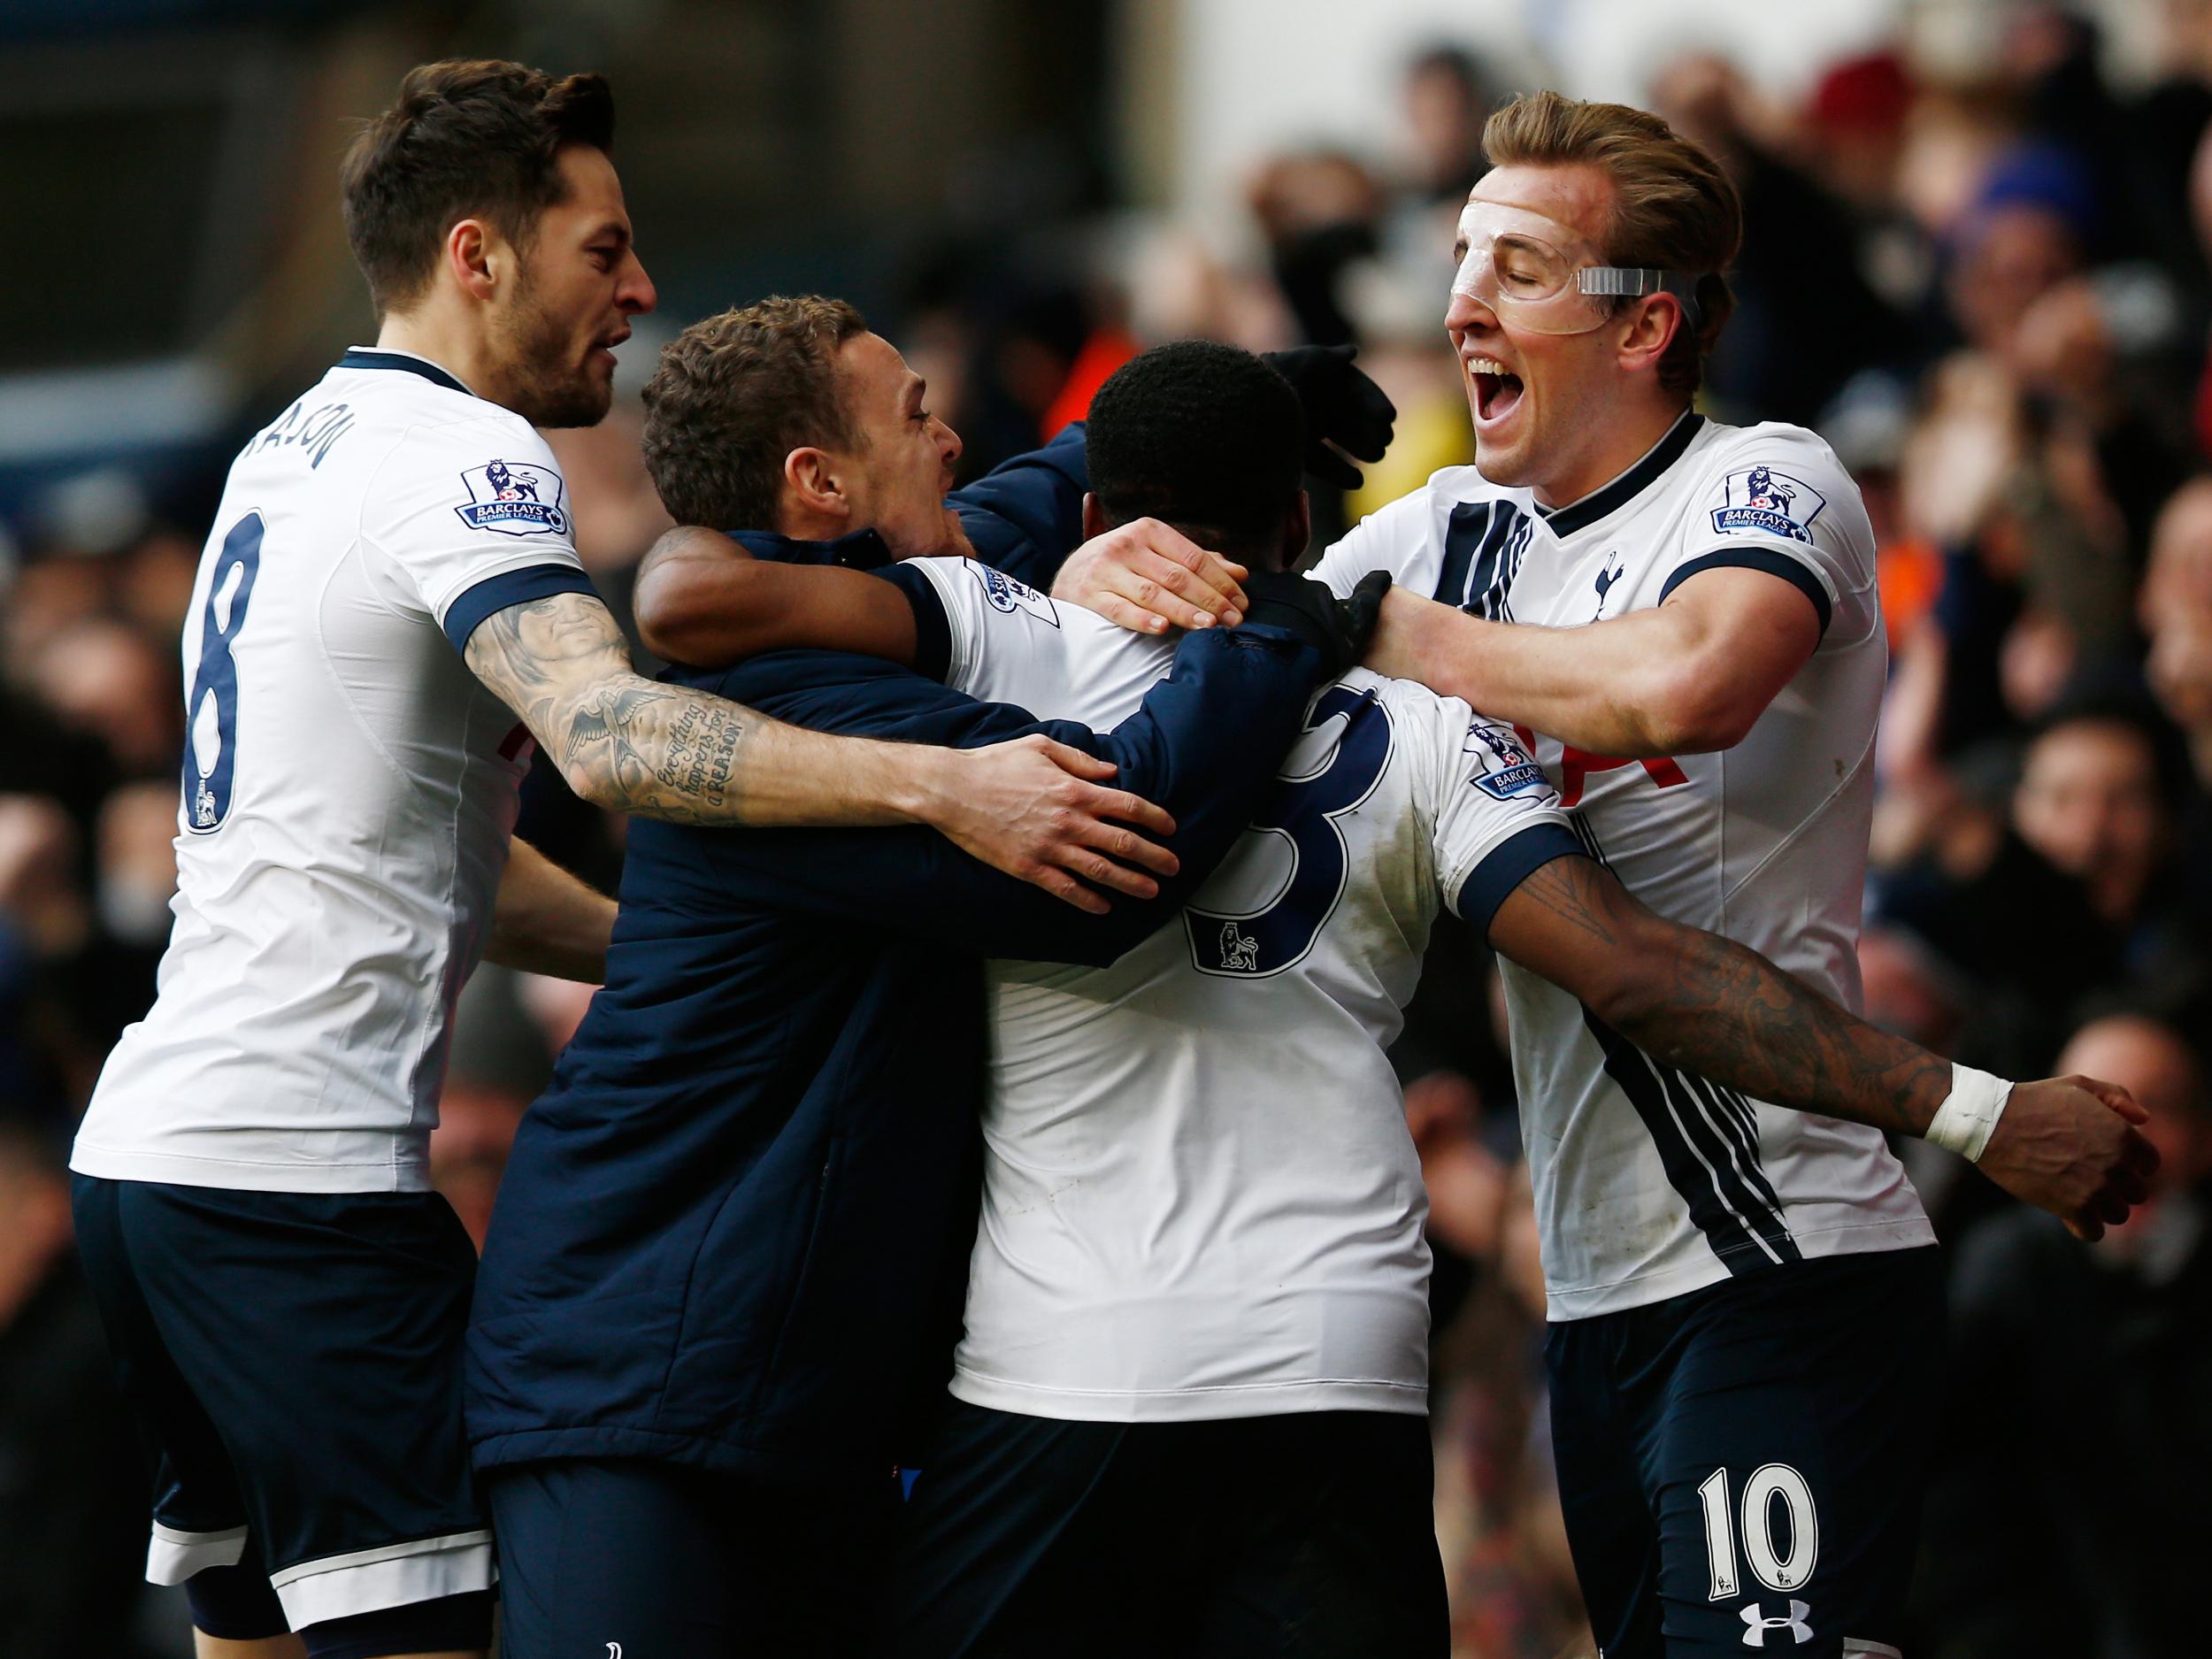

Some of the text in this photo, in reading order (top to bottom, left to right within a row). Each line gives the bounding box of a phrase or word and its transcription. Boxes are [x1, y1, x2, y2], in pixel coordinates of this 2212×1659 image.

[476, 512, 543, 523] PREMIER LEAGUE
[477, 503, 544, 517] BARCLAYS
[1723, 518, 1786, 535] PREMIER LEAGUE
[1724, 511, 1790, 529] BARCLAYS
[182, 507, 268, 835] 8
[657, 704, 708, 787] Everything
[676, 710, 726, 796] happens for
[708, 722, 743, 807] a REASON
[1182, 684, 1395, 979] 3
[1698, 1463, 1819, 1601] 10
